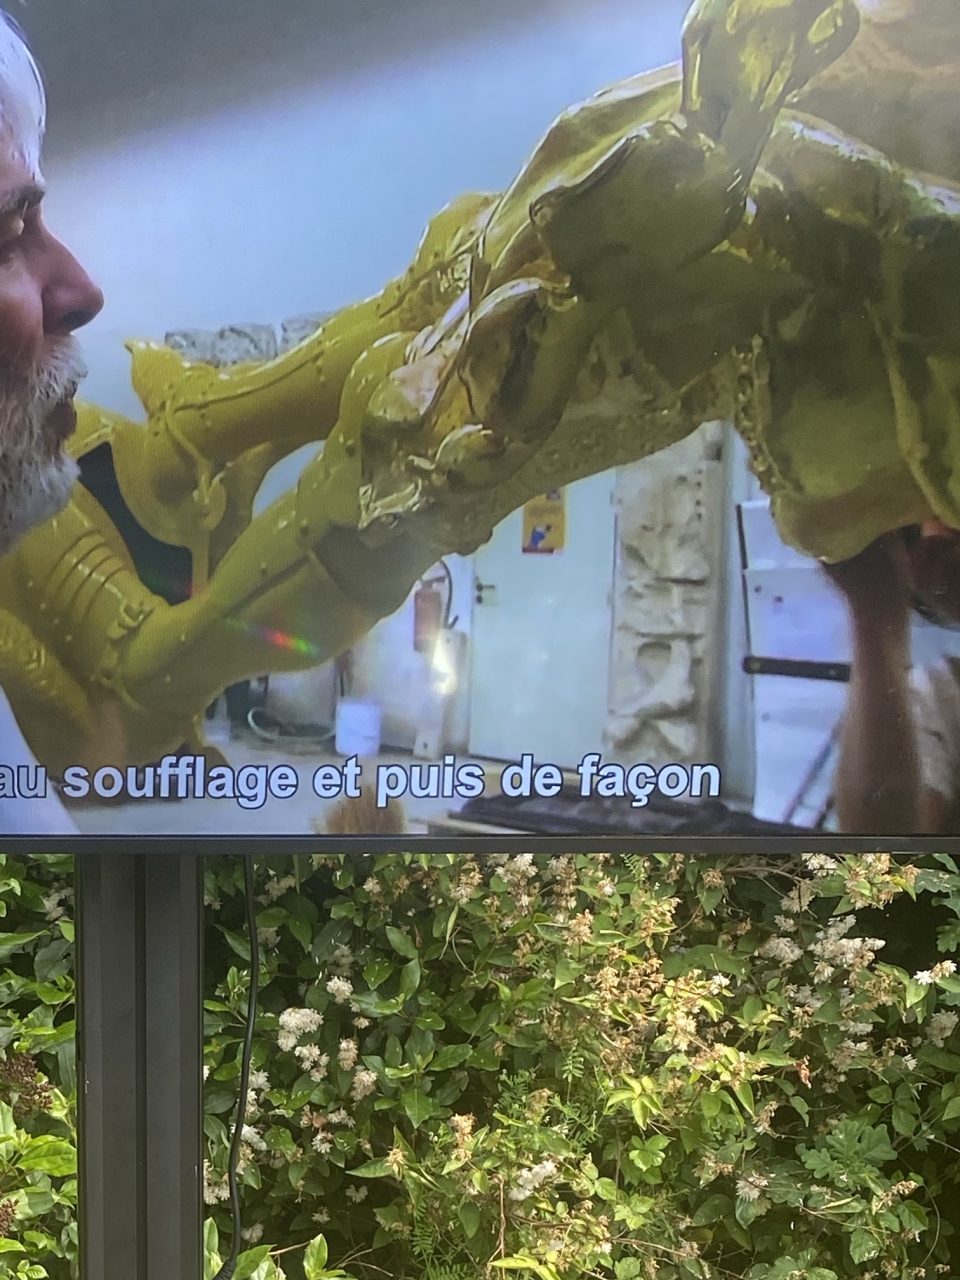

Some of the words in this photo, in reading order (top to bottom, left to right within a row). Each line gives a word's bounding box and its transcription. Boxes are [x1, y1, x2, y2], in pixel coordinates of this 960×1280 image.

[62, 753, 299, 808] soufflage
[312, 754, 362, 798] et
[376, 754, 486, 807] puis
[500, 755, 563, 798] de
[576, 754, 722, 807] façon
